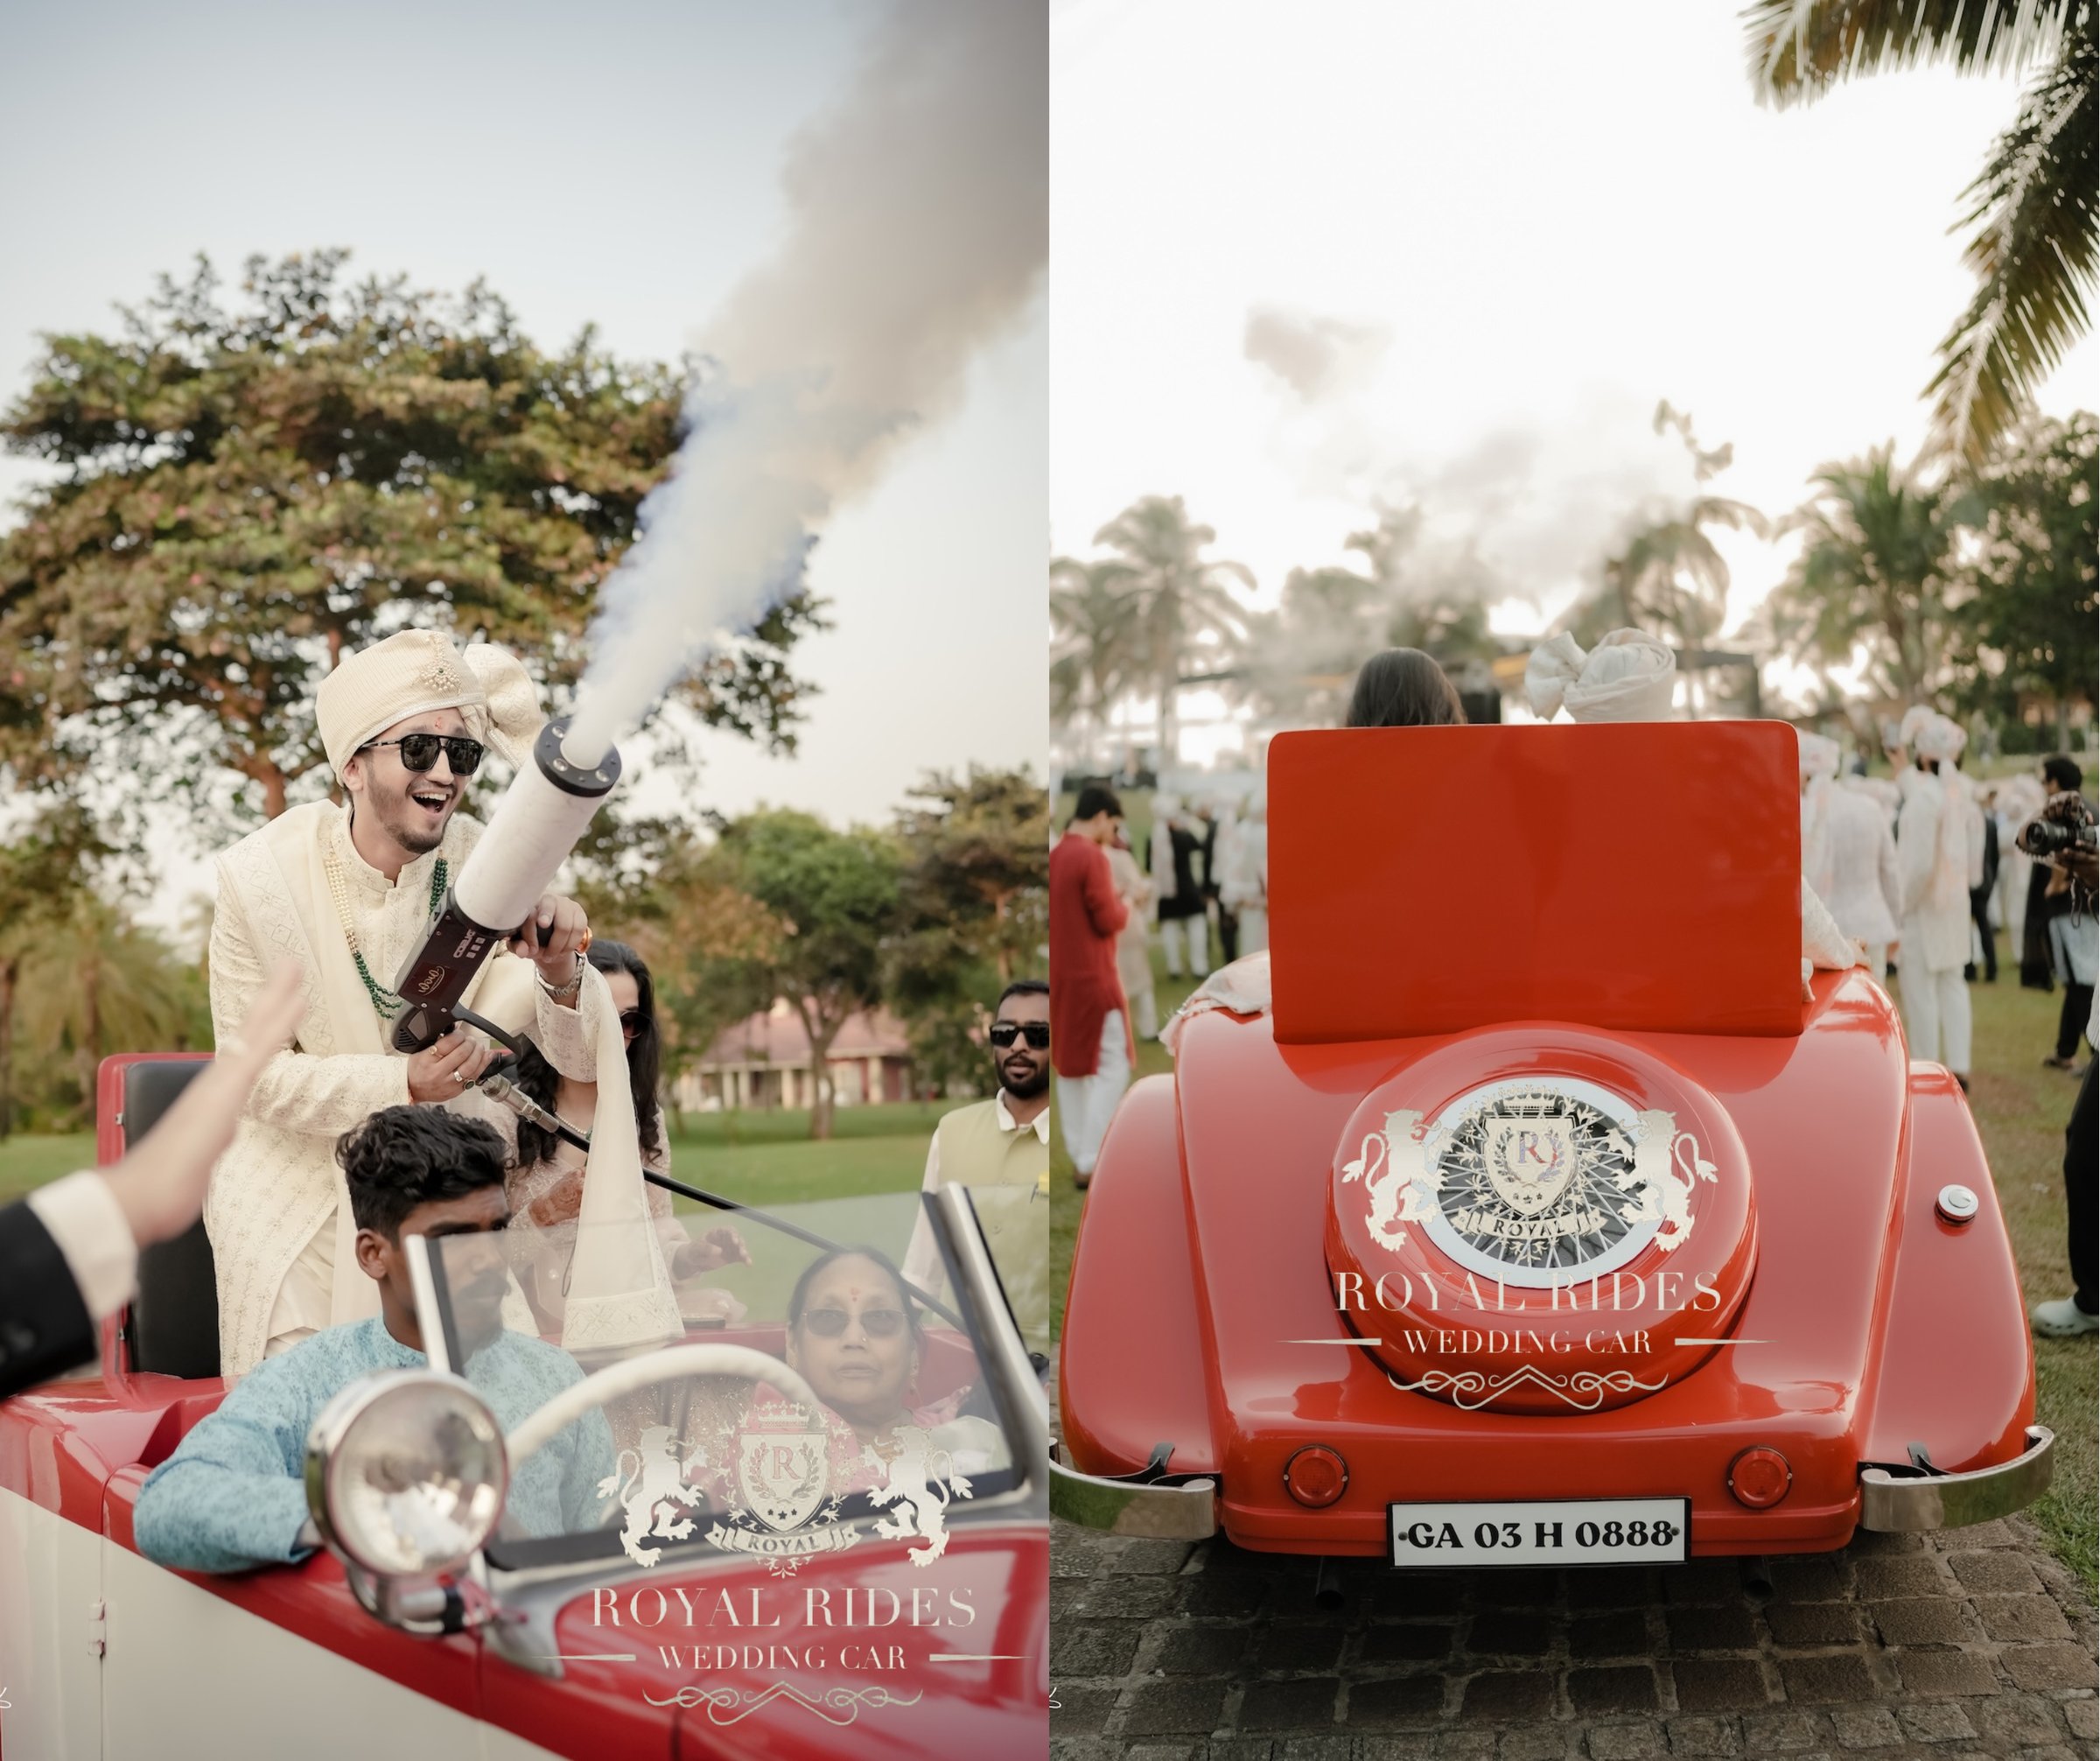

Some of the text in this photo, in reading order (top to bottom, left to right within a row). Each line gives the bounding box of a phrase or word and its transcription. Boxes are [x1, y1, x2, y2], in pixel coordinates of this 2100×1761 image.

[1408, 1520, 1674, 1548] GA 03 H 0888
